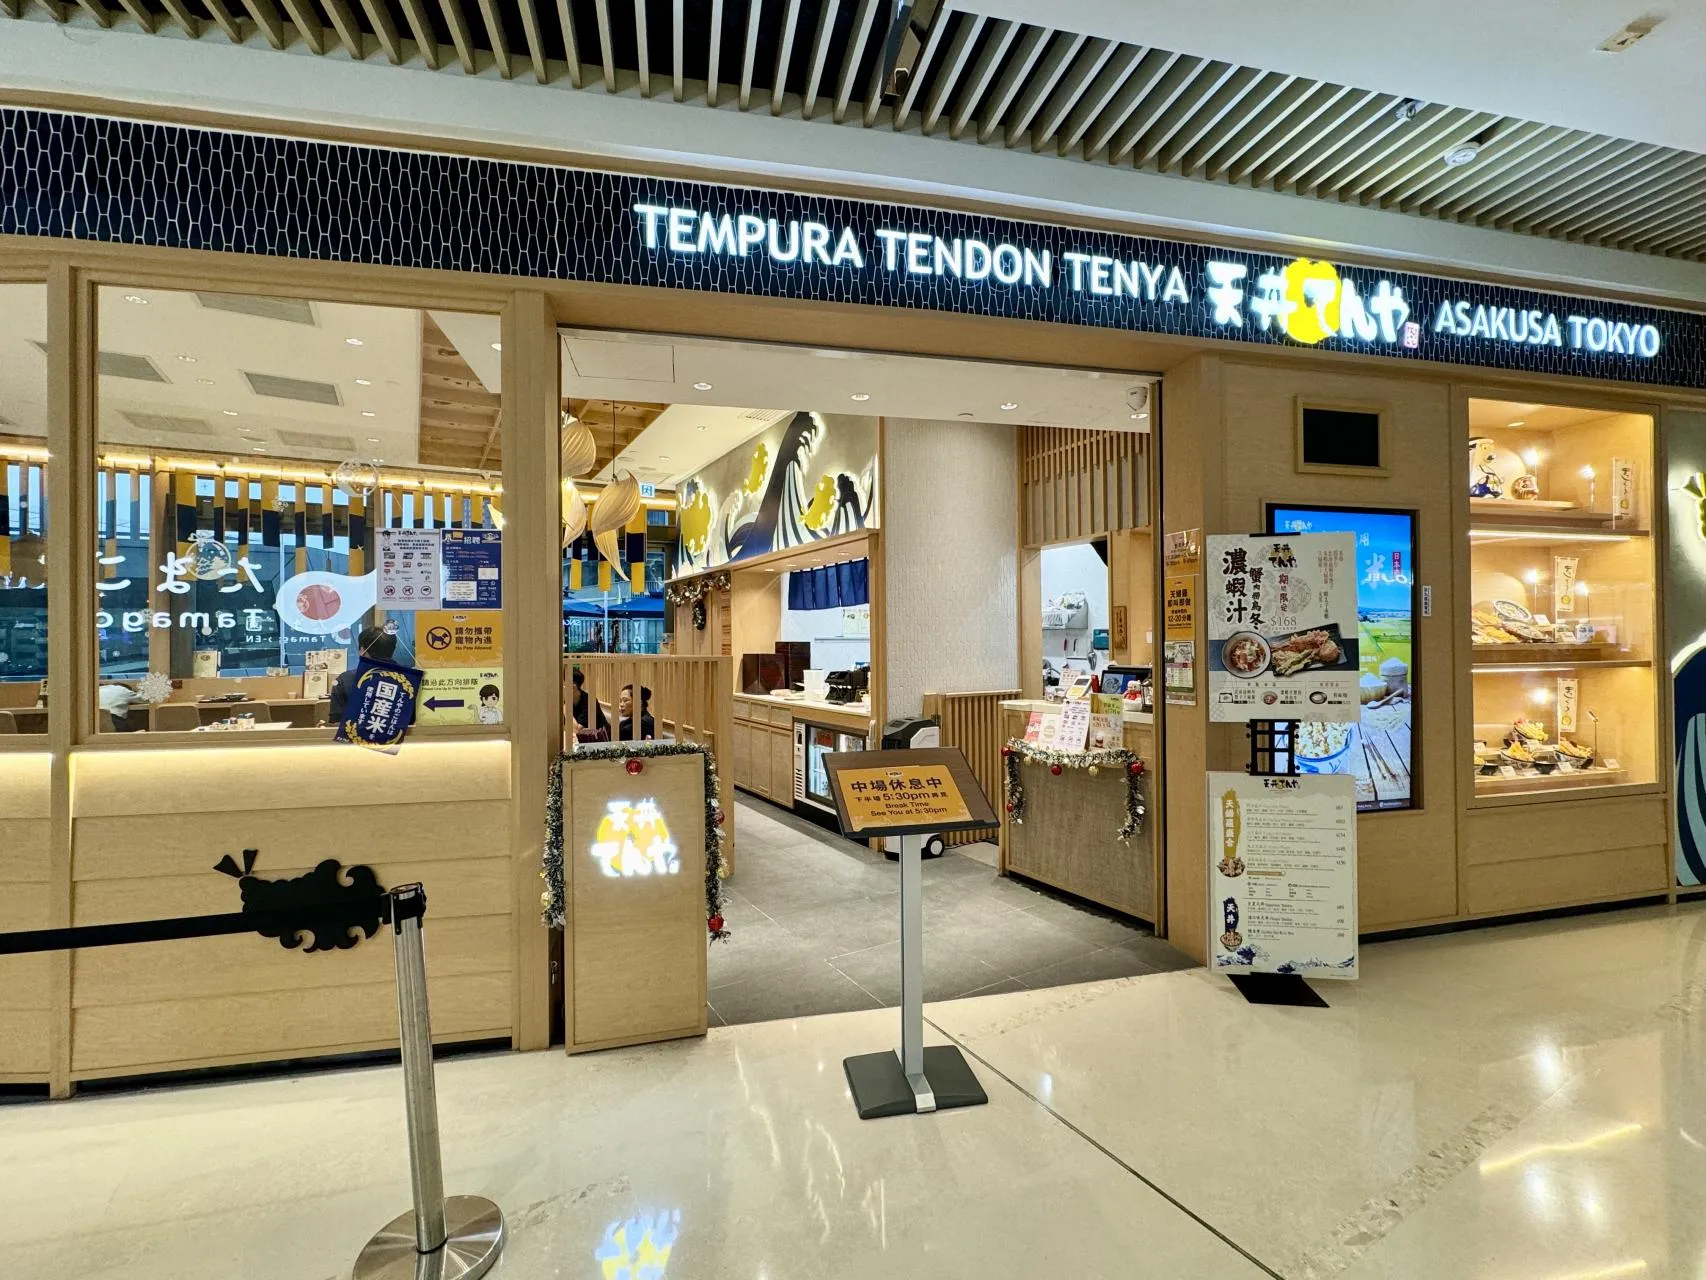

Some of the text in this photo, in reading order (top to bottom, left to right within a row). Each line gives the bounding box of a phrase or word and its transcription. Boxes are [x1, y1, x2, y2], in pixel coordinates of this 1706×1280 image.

[633, 203, 1190, 304] TEMPURA TENDON TENYA
[1434, 299, 1563, 348] ASAKUSA
[1567, 314, 1661, 359] TOKYO
[1222, 547, 1248, 624] 濃蝦汁
[1270, 615, 1297, 628] $168
[851, 777, 943, 793] 中場休息中
[882, 791, 930, 801] 5:30pm
[885, 801, 909, 809] Break
[914, 807, 948, 815] 5:30pm
